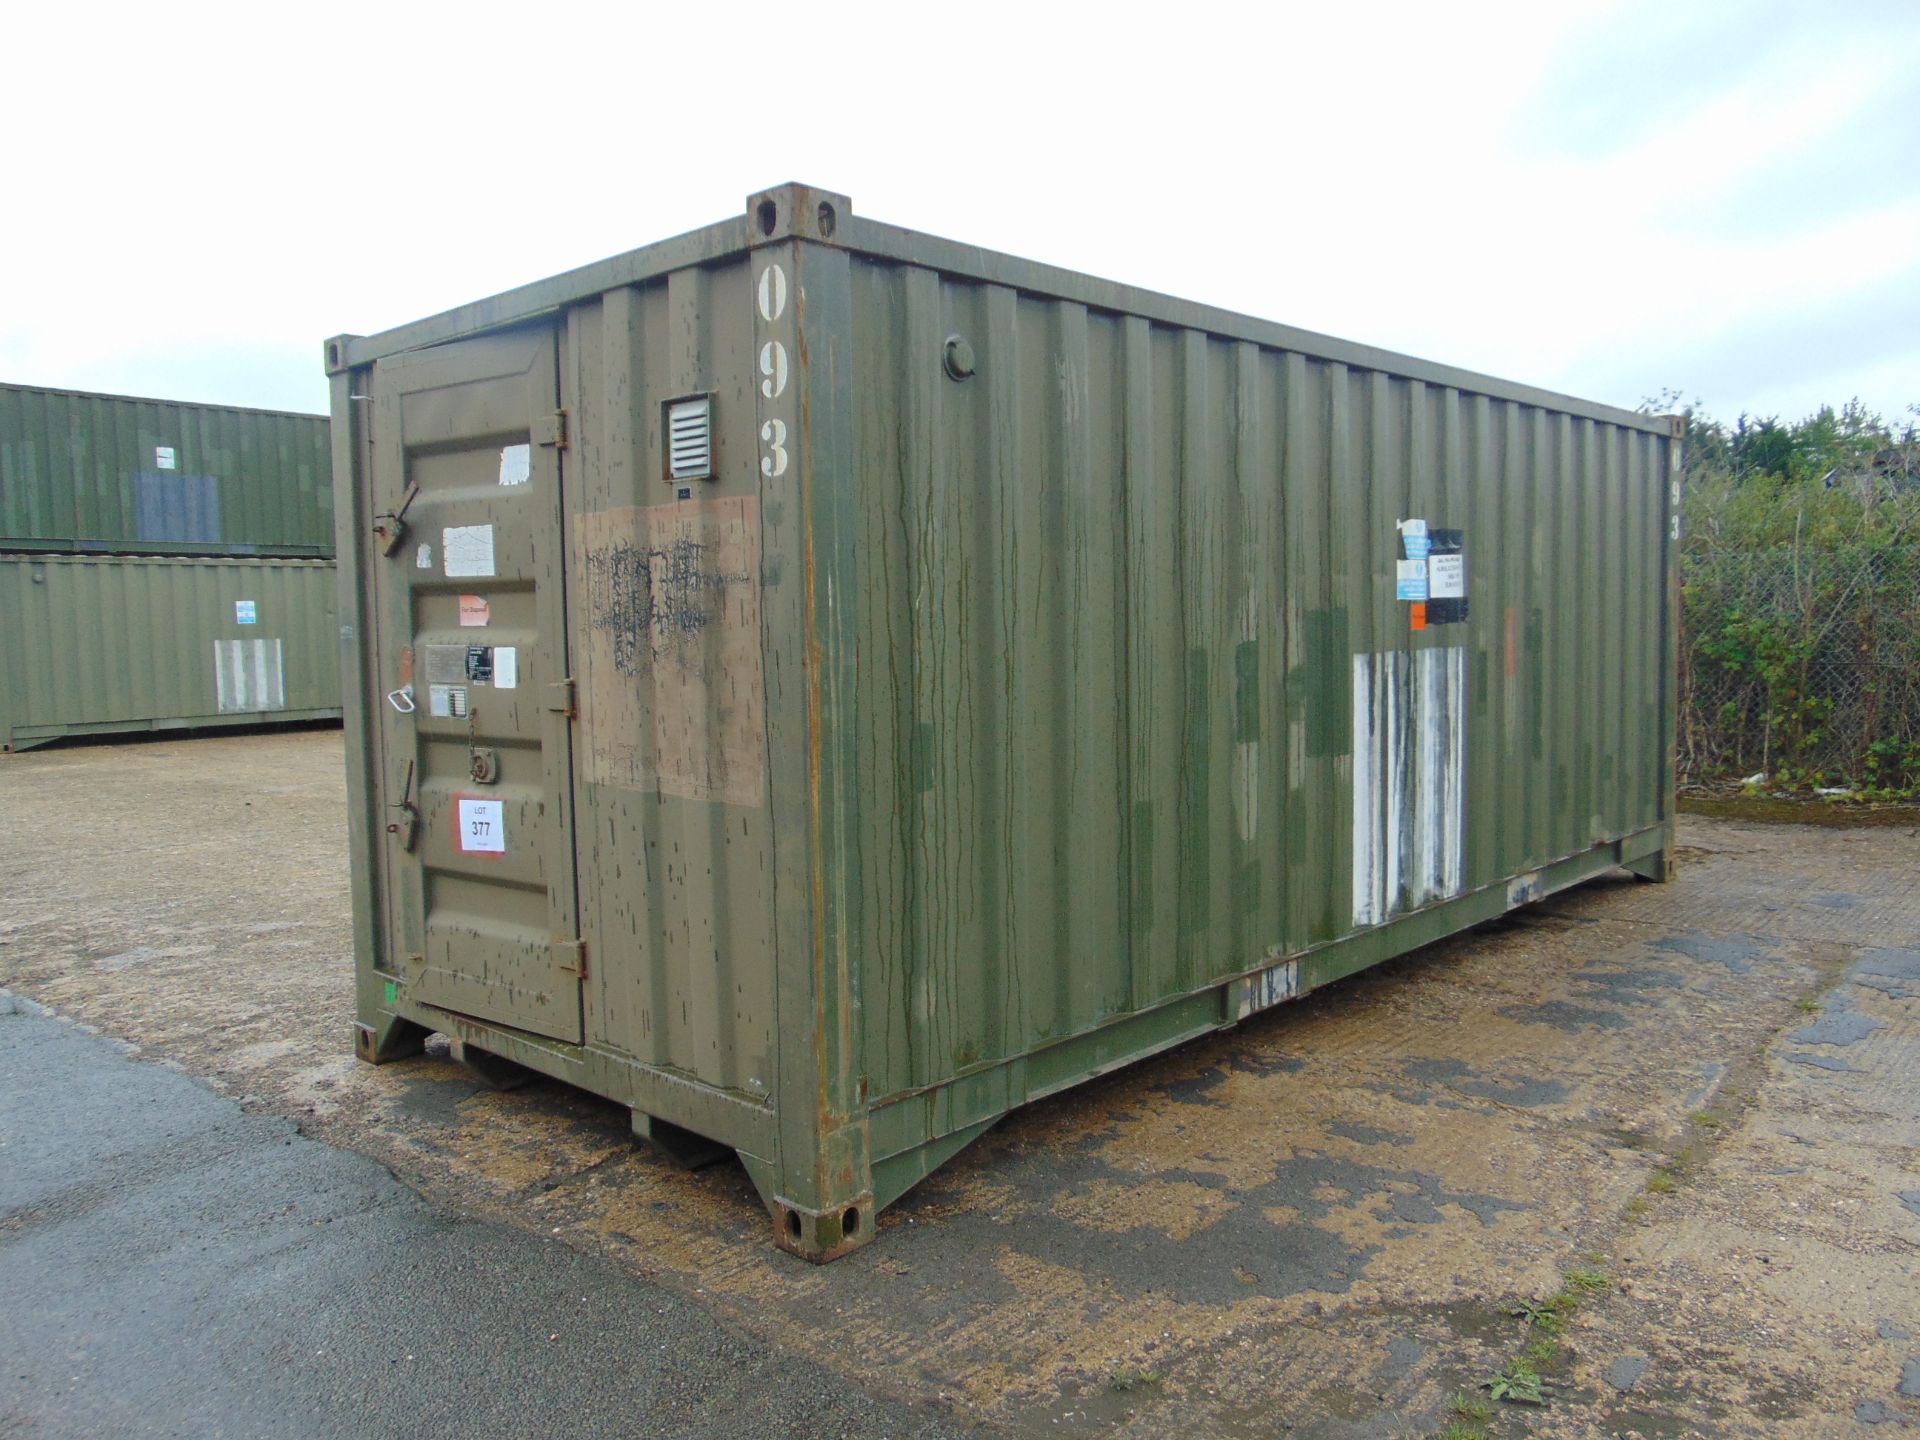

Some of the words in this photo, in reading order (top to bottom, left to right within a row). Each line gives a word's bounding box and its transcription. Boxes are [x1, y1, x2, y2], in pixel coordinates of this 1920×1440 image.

[758, 264, 788, 477] 093
[474, 806, 487, 815] LOT
[471, 821, 491, 836] 377
